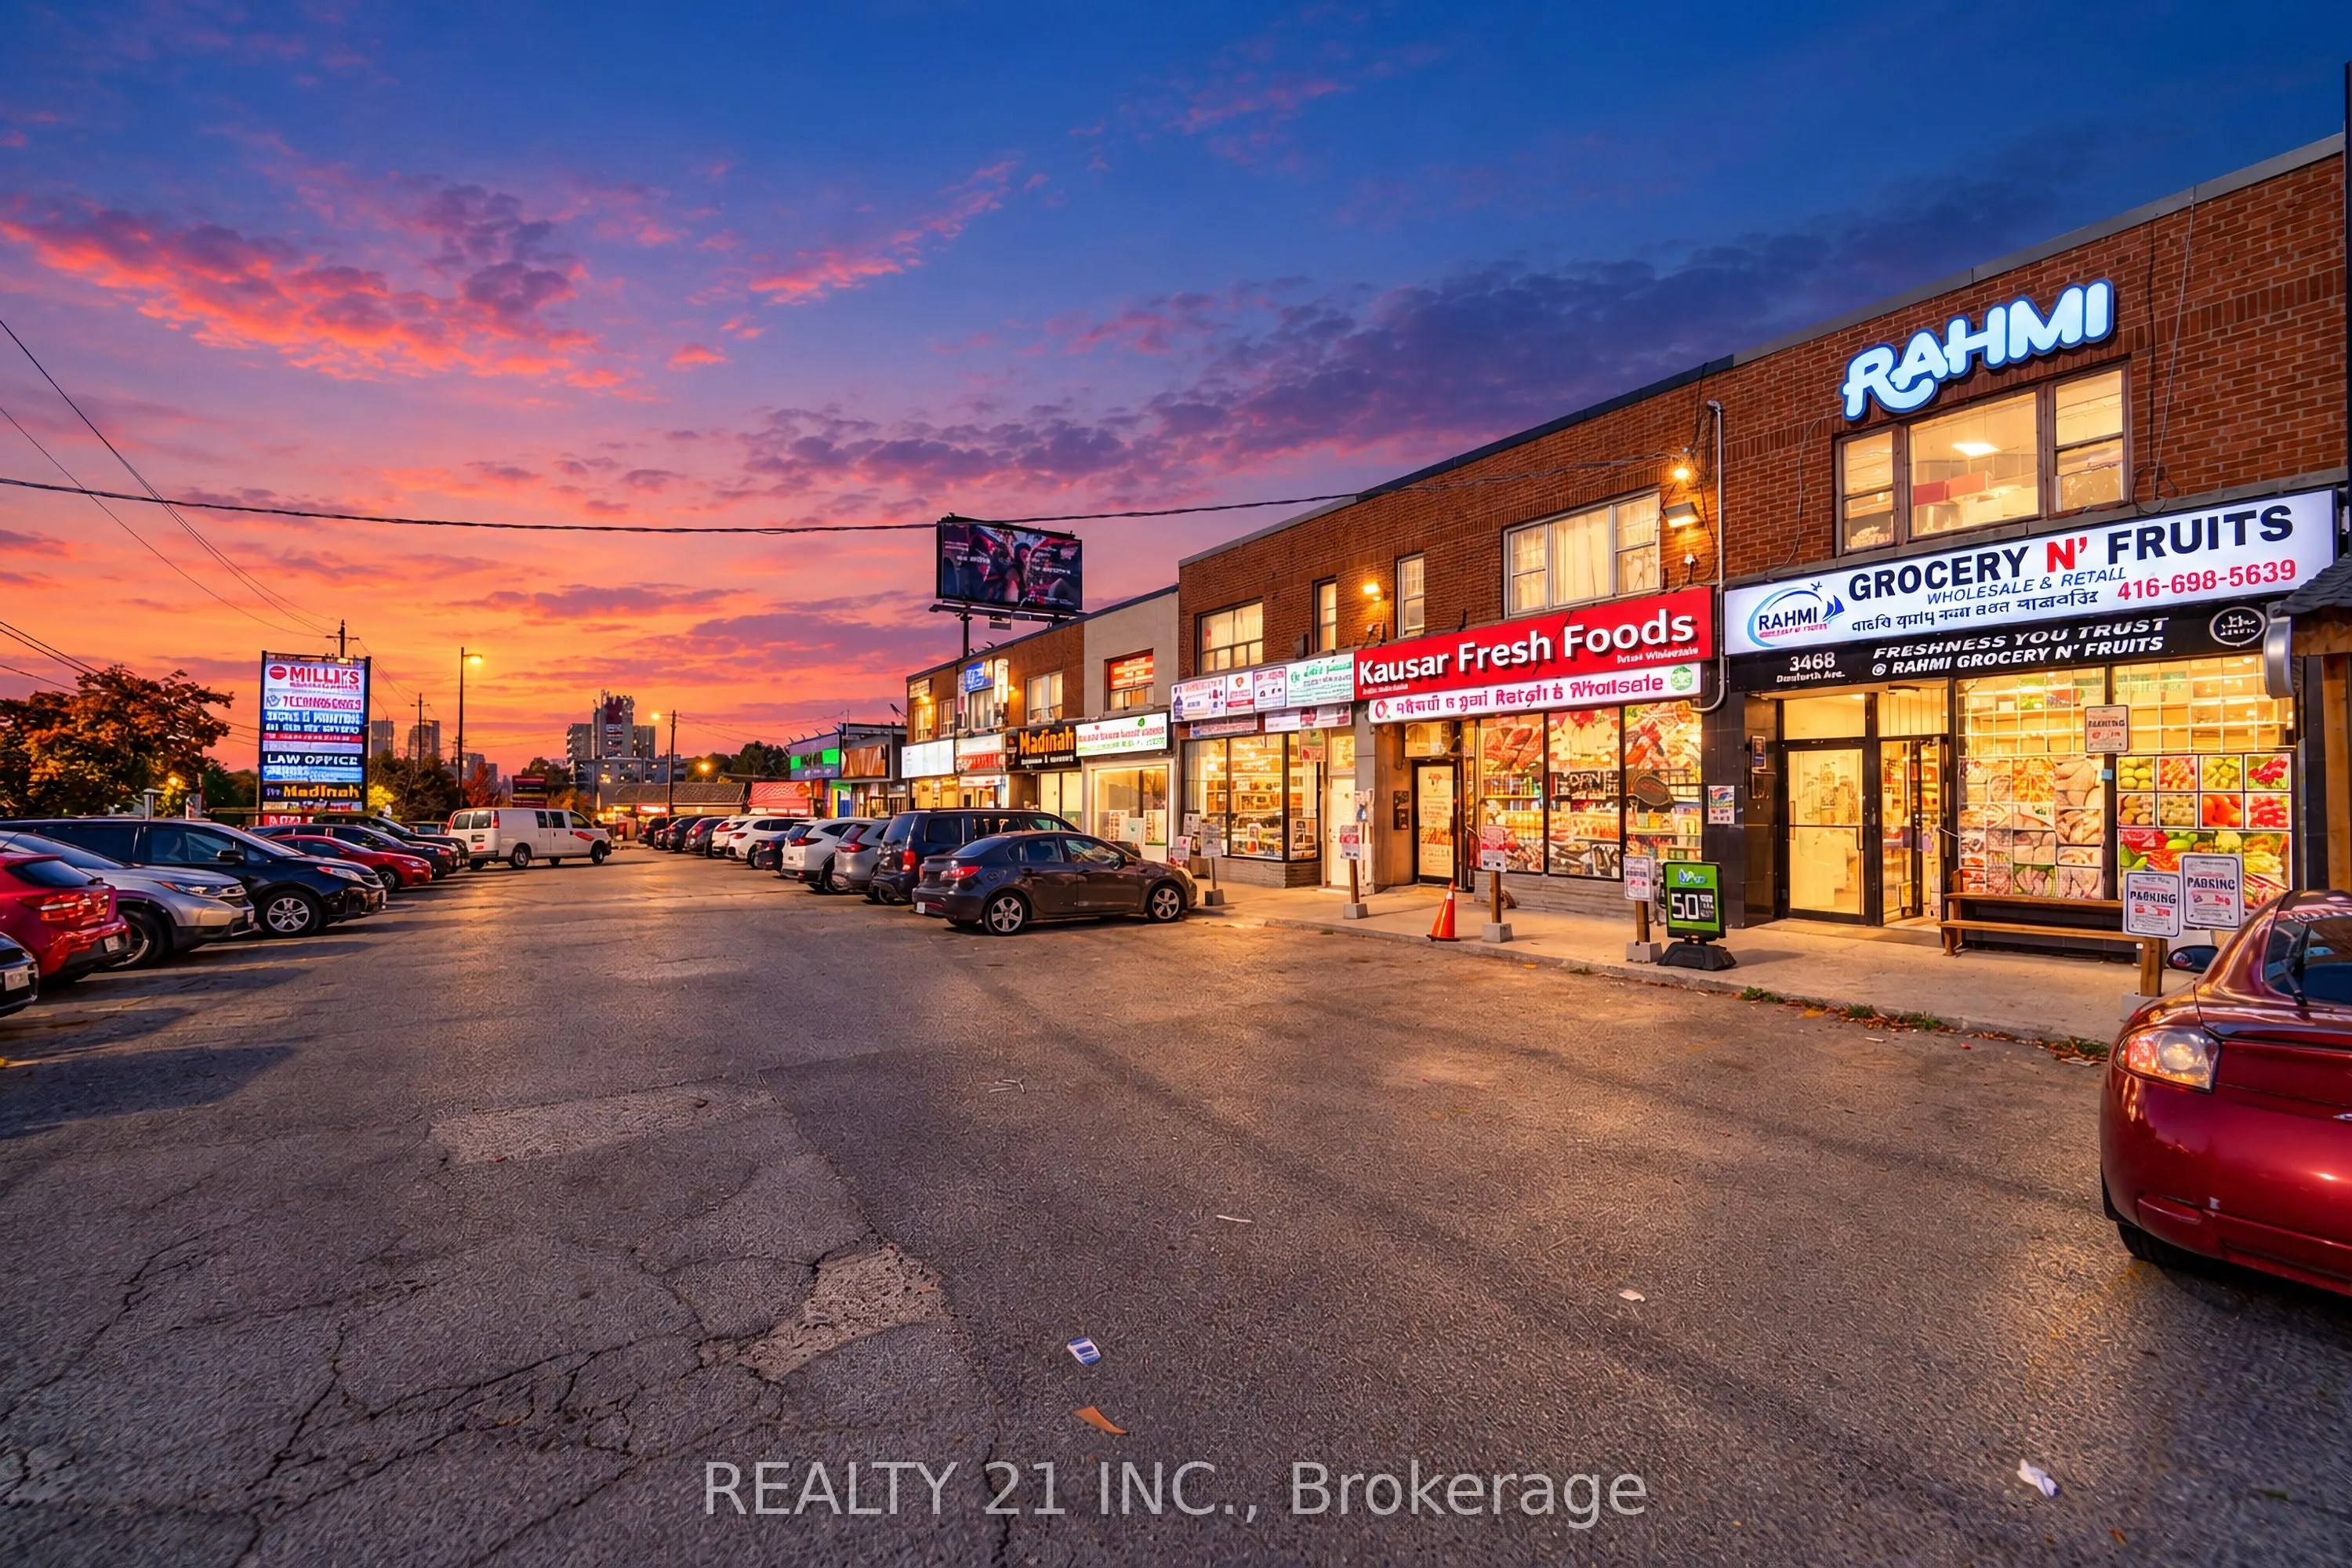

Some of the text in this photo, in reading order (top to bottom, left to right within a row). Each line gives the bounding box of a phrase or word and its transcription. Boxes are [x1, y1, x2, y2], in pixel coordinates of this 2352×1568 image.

[1841, 280, 2113, 419] RAHMI
[1849, 505, 2294, 602] GROCERY N' FRUITS
[1927, 579, 2035, 604] WHOLESALE
[2039, 576, 2053, 590] &
[2117, 559, 2296, 601] 416-698-5639
[1759, 606, 1817, 631] RAHMI
[1358, 608, 1694, 687] Kausar Fresh Foods
[1873, 617, 2169, 659] FRESHNESS YOU TRUST
[1789, 652, 1836, 672] 3468
[1892, 656, 1952, 674] RAHMI
[1957, 647, 2051, 668] GROCERY
[2084, 637, 2164, 657] FRUITS
[1019, 726, 1074, 755] Madinah
[267, 754, 300, 764] LAW
[1671, 893, 1700, 920] 50
